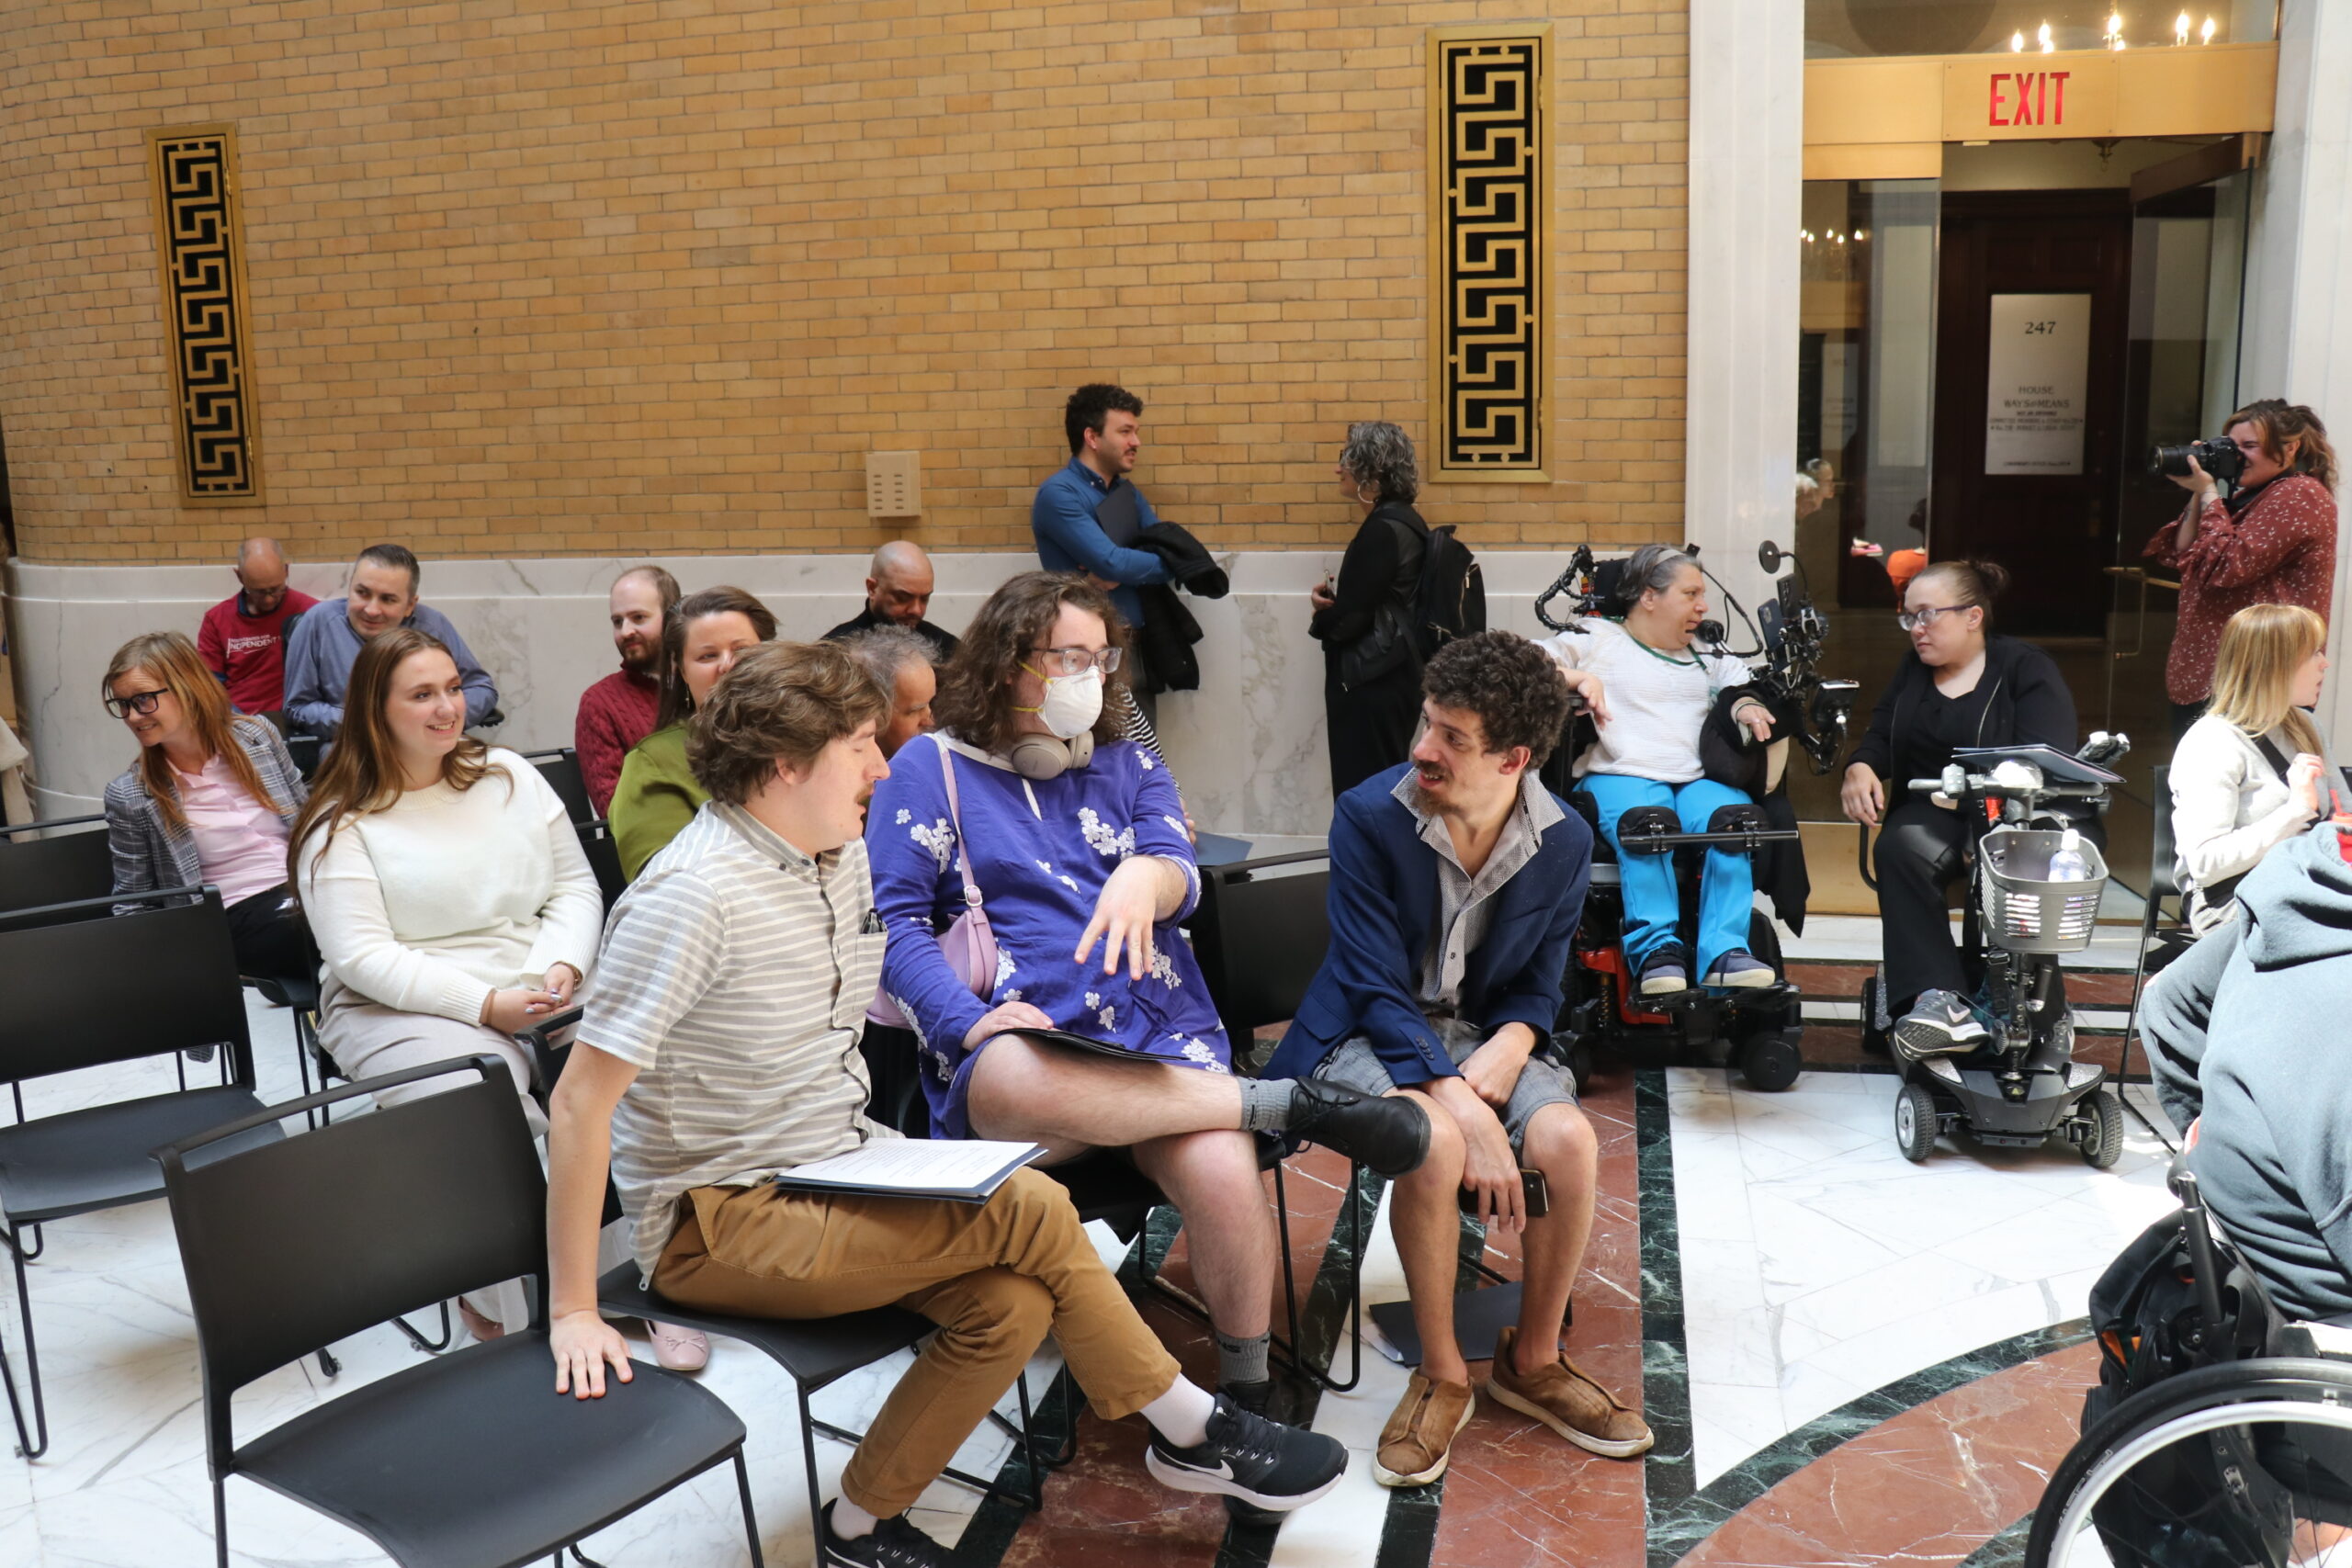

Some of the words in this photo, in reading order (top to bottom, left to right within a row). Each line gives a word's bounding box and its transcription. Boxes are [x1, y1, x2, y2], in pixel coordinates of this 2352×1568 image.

[1989, 72, 2070, 126] EXIT
[2025, 321, 2056, 334] 247
[2018, 386, 2054, 395] HOUSE
[2004, 399, 2030, 408] WAYS
[2038, 399, 2070, 409] MEANS
